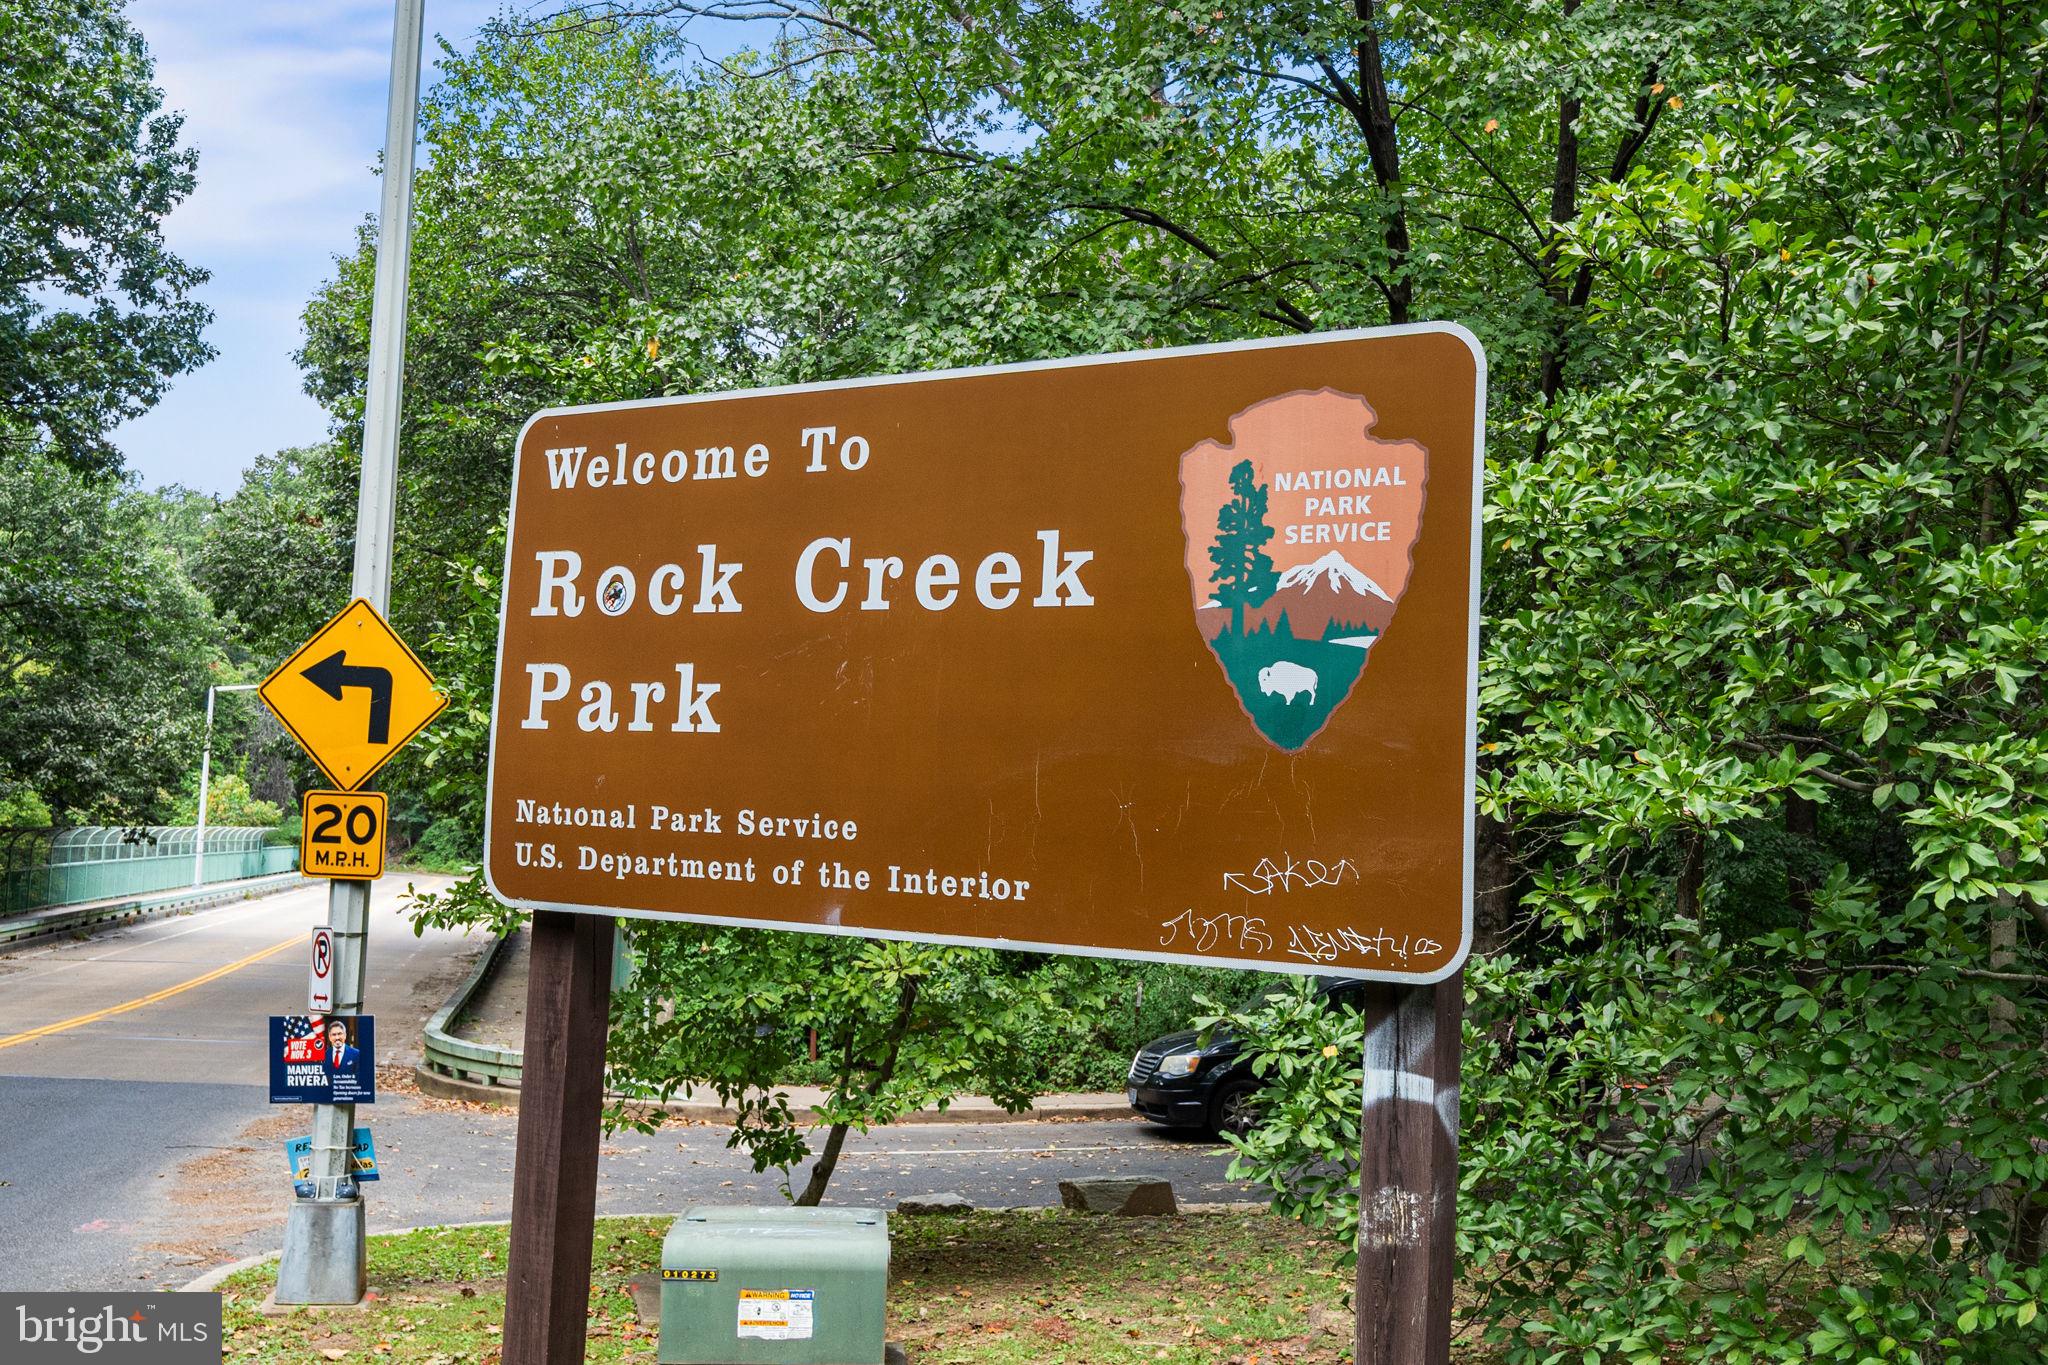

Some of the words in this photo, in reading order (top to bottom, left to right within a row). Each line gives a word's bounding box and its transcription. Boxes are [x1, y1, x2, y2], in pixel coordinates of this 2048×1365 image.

[545, 443, 770, 489] Welcome
[801, 425, 870, 473] To
[1274, 466, 1407, 492] NATIONAL
[1305, 495, 1372, 517] PARK
[1284, 521, 1391, 545] SERVICE
[531, 544, 743, 617] Rock
[795, 530, 1095, 613] Creek
[521, 662, 721, 733] Park
[311, 803, 377, 845] 20
[515, 799, 636, 829] National
[650, 806, 722, 834] Park
[737, 809, 858, 841] Service
[315, 851, 370, 867] M.P.H.
[515, 841, 563, 869] U.S.
[578, 846, 756, 883] Department
[772, 860, 805, 886] of
[819, 863, 871, 891] the
[887, 866, 1030, 902] Interior
[290, 1050, 305, 1059] NOV.
[306, 1049, 312, 1059] 3
[291, 1040, 307, 1050] VOTE
[287, 1065, 325, 1075] MANUEL
[287, 1075, 328, 1086] RIVERA
[663, 1270, 716, 1279] 010273
[752, 1290, 785, 1299] WARNING
